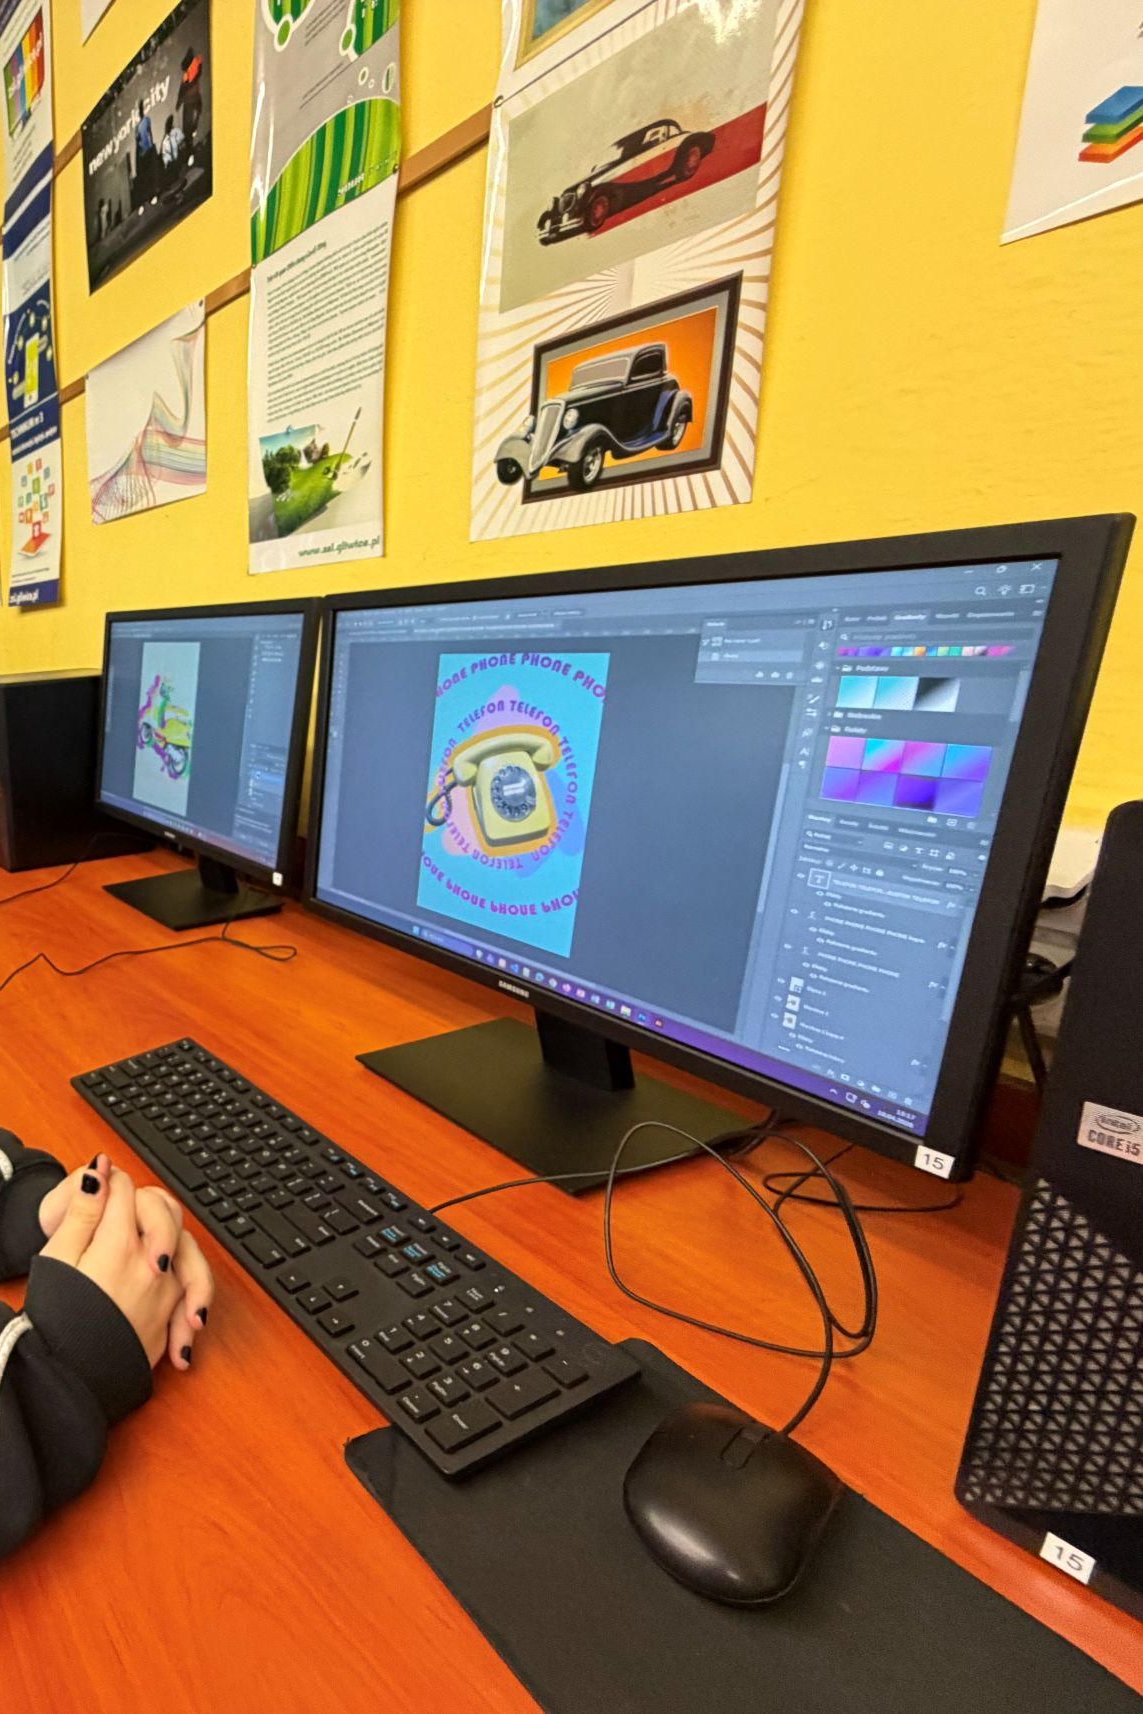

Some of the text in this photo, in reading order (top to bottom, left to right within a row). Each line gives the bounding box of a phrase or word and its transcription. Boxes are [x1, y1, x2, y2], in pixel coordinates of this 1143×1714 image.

[471, 653, 517, 674] PHONE
[521, 653, 572, 677] PHONE
[457, 700, 505, 733] TELEFON
[509, 700, 560, 736] TELEFON
[559, 736, 578, 805] TELEFON
[924, 1153, 945, 1170] 15
[1054, 1545, 1084, 1571] 15
